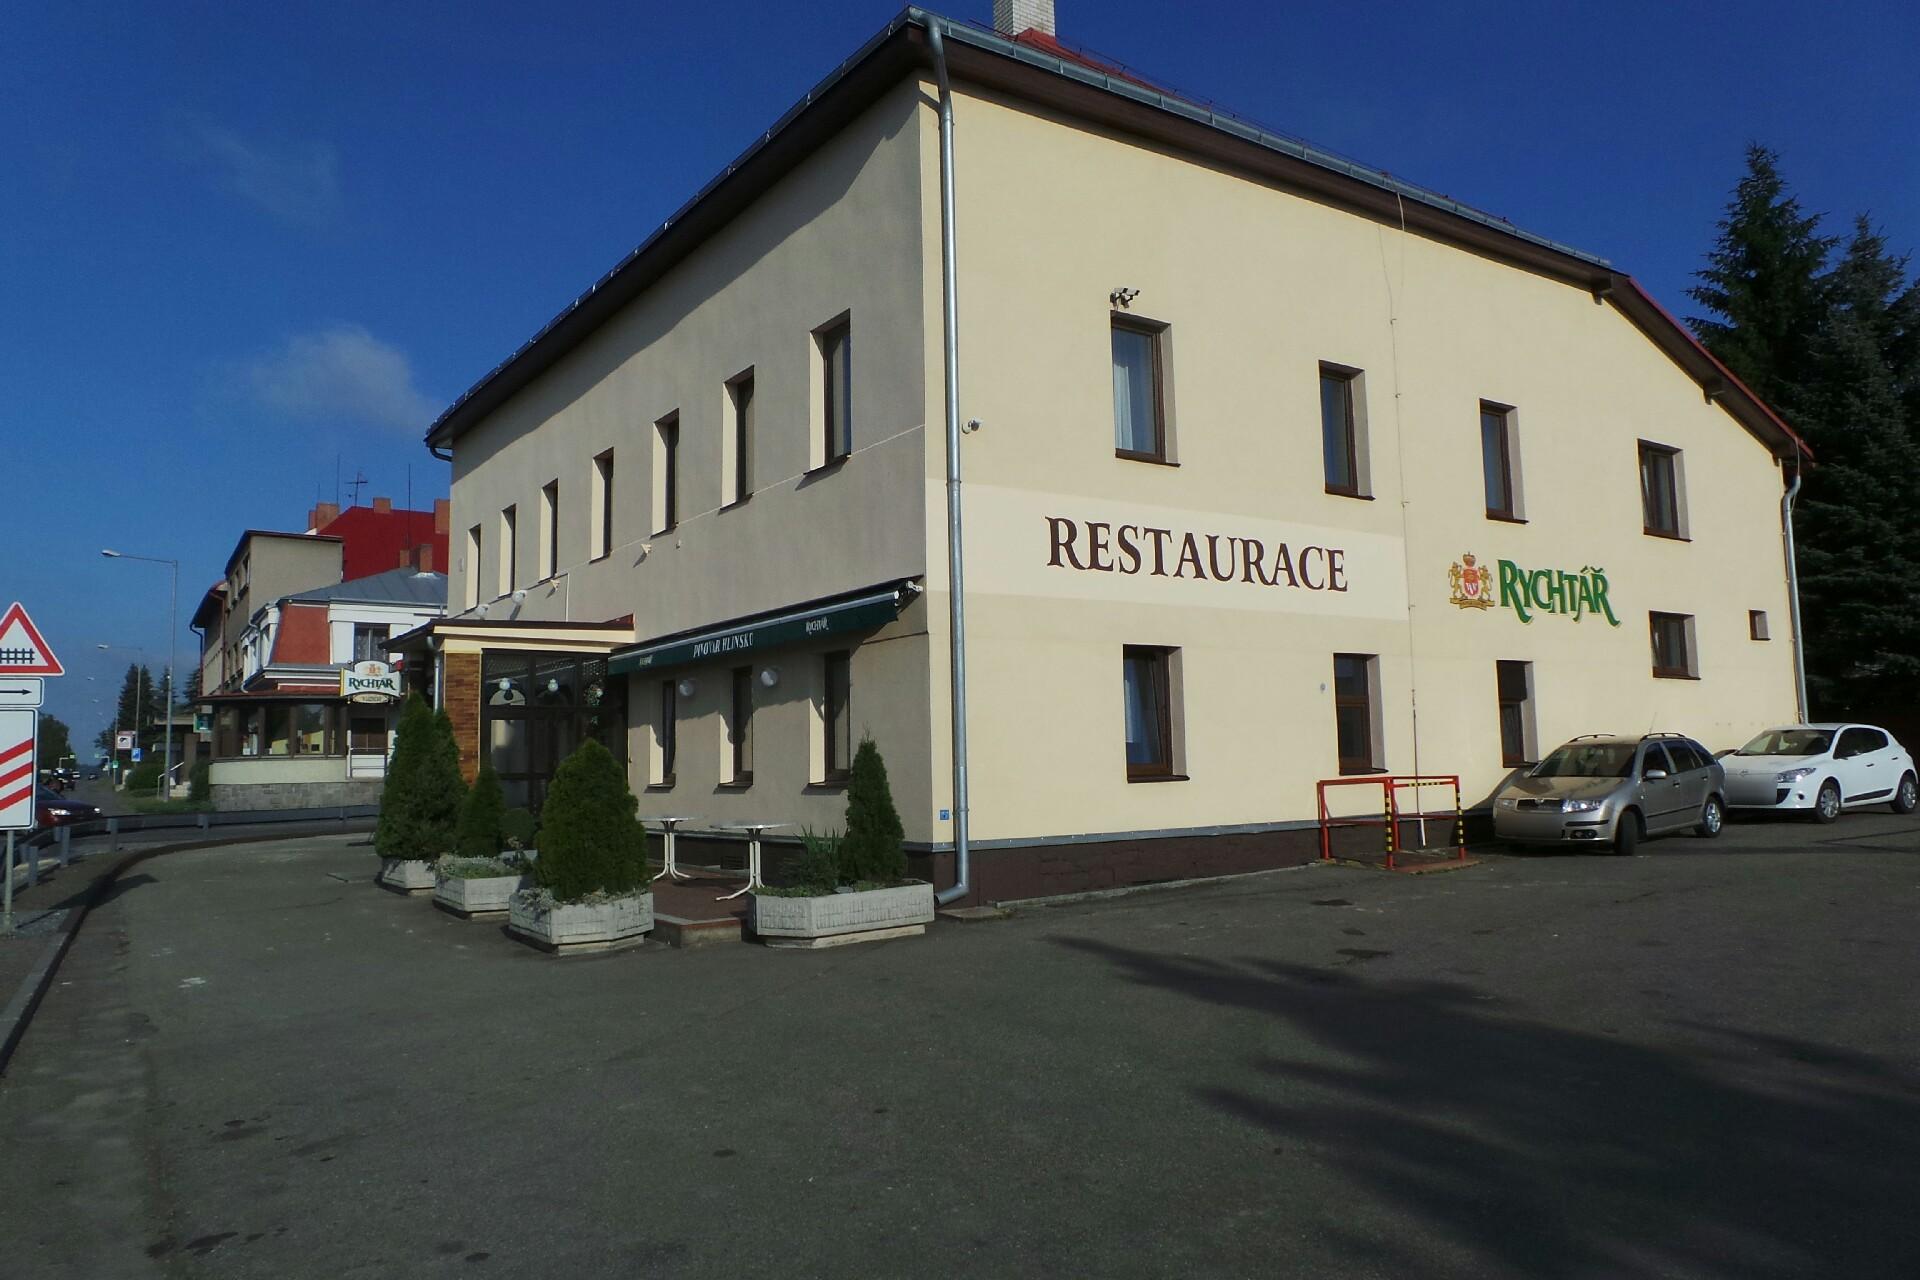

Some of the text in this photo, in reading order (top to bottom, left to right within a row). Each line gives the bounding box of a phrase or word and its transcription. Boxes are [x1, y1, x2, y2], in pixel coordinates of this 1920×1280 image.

[1045, 516, 1348, 592] RESTAURACE
[1498, 559, 1620, 627] RYCHTÁŘ
[722, 632, 754, 651] HLINSKO
